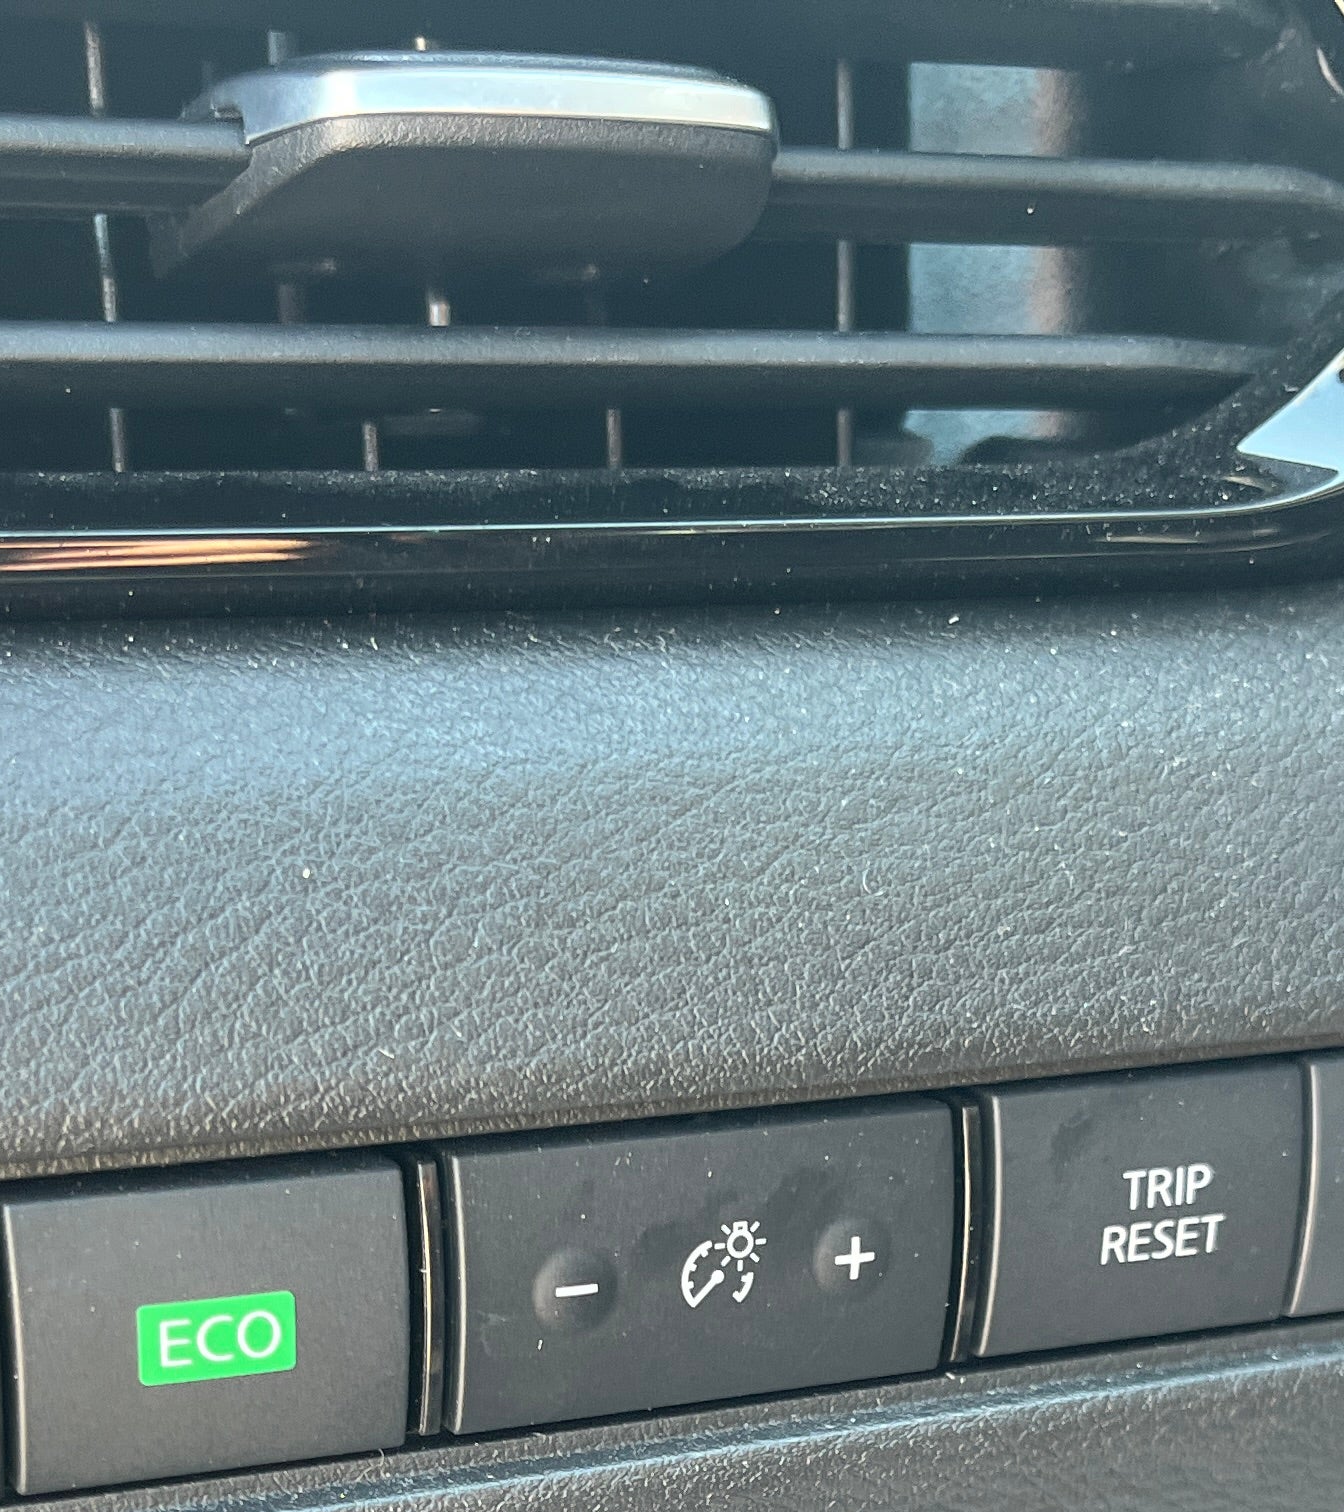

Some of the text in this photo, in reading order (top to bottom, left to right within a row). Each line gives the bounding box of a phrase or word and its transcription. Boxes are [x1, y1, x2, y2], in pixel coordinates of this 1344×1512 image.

[1122, 1163, 1214, 1210] TRIP
[1100, 1213, 1225, 1265] RESET
[159, 1309, 282, 1368] ECO
